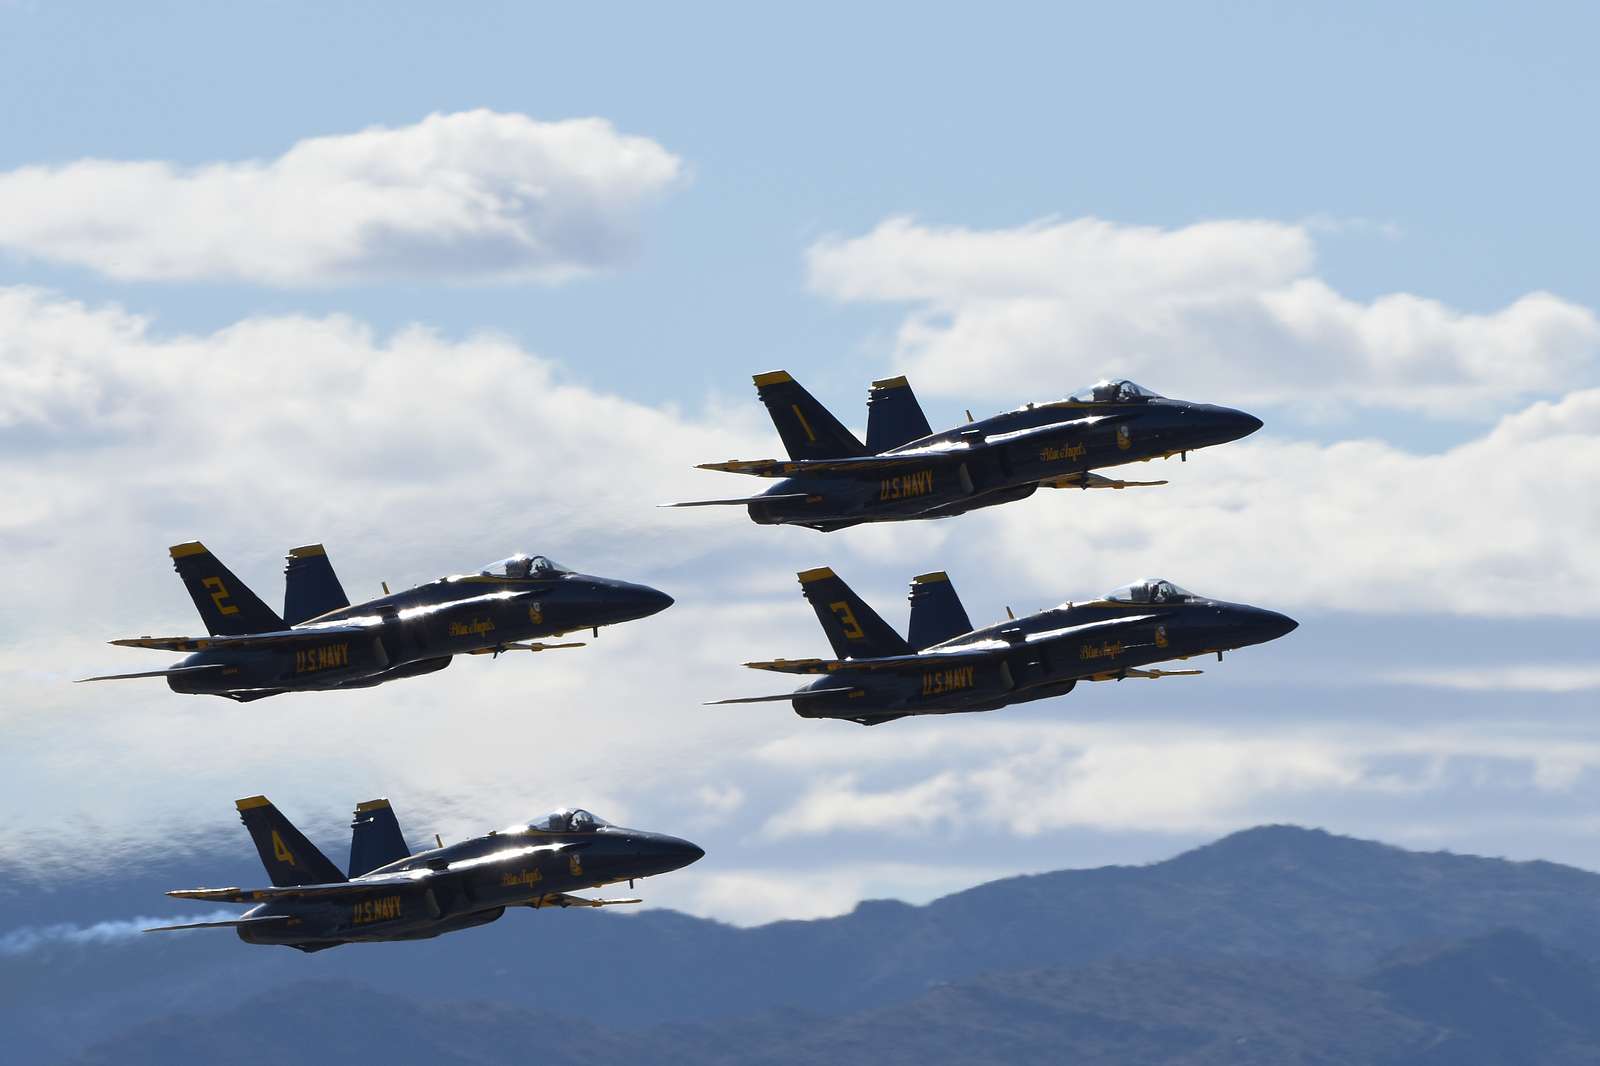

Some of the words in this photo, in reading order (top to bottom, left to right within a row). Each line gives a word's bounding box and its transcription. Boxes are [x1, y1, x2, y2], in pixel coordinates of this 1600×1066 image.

[792, 404, 816, 442] 1
[202, 576, 239, 616] 2
[830, 601, 864, 639] 3
[271, 830, 295, 864] 4
